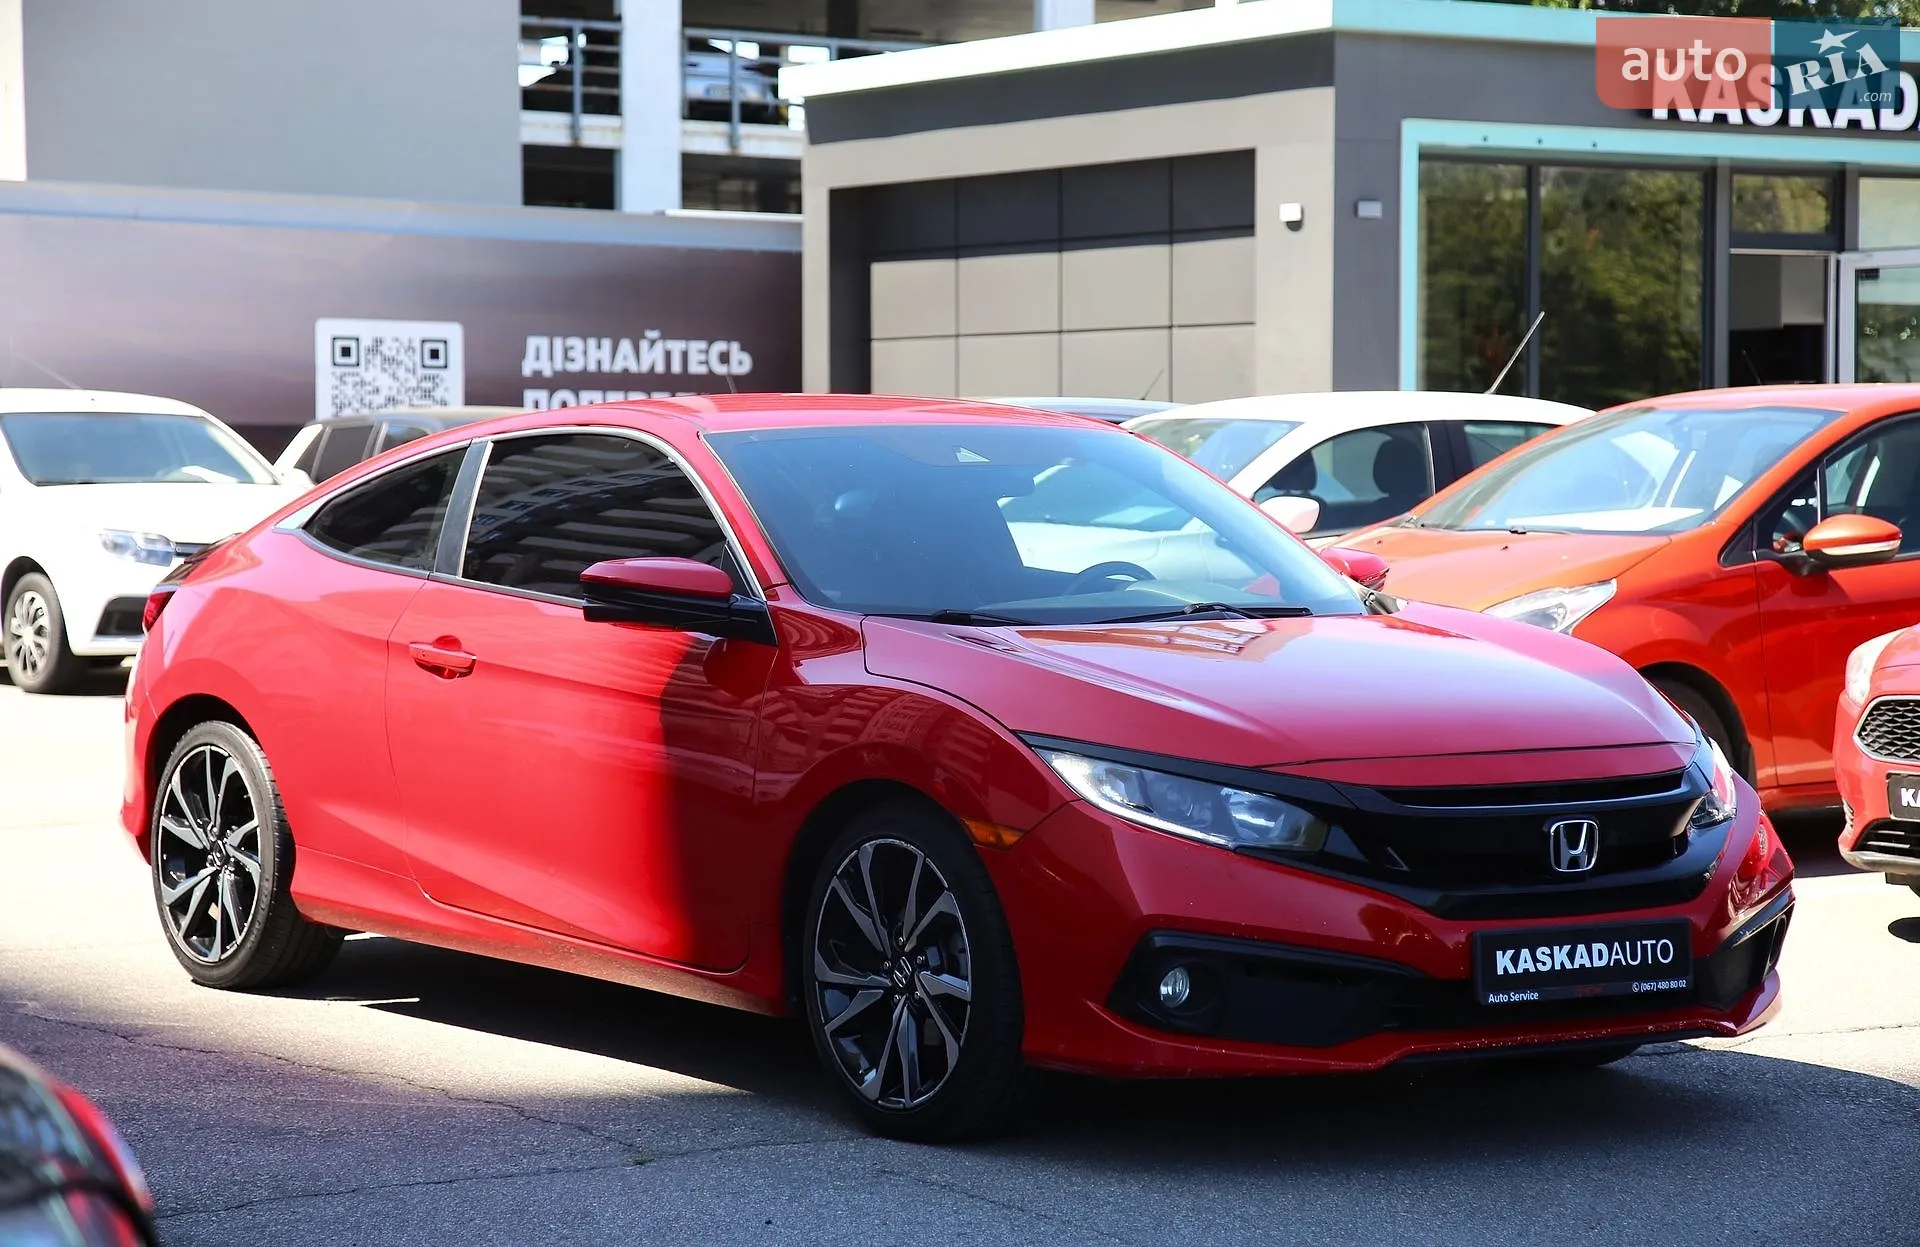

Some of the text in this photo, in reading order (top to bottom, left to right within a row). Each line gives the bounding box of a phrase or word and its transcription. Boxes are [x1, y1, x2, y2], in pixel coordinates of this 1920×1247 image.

[522, 329, 753, 377] ДІЗНАЙТЕСЬ
[1488, 990, 1539, 1003] Auto Service
